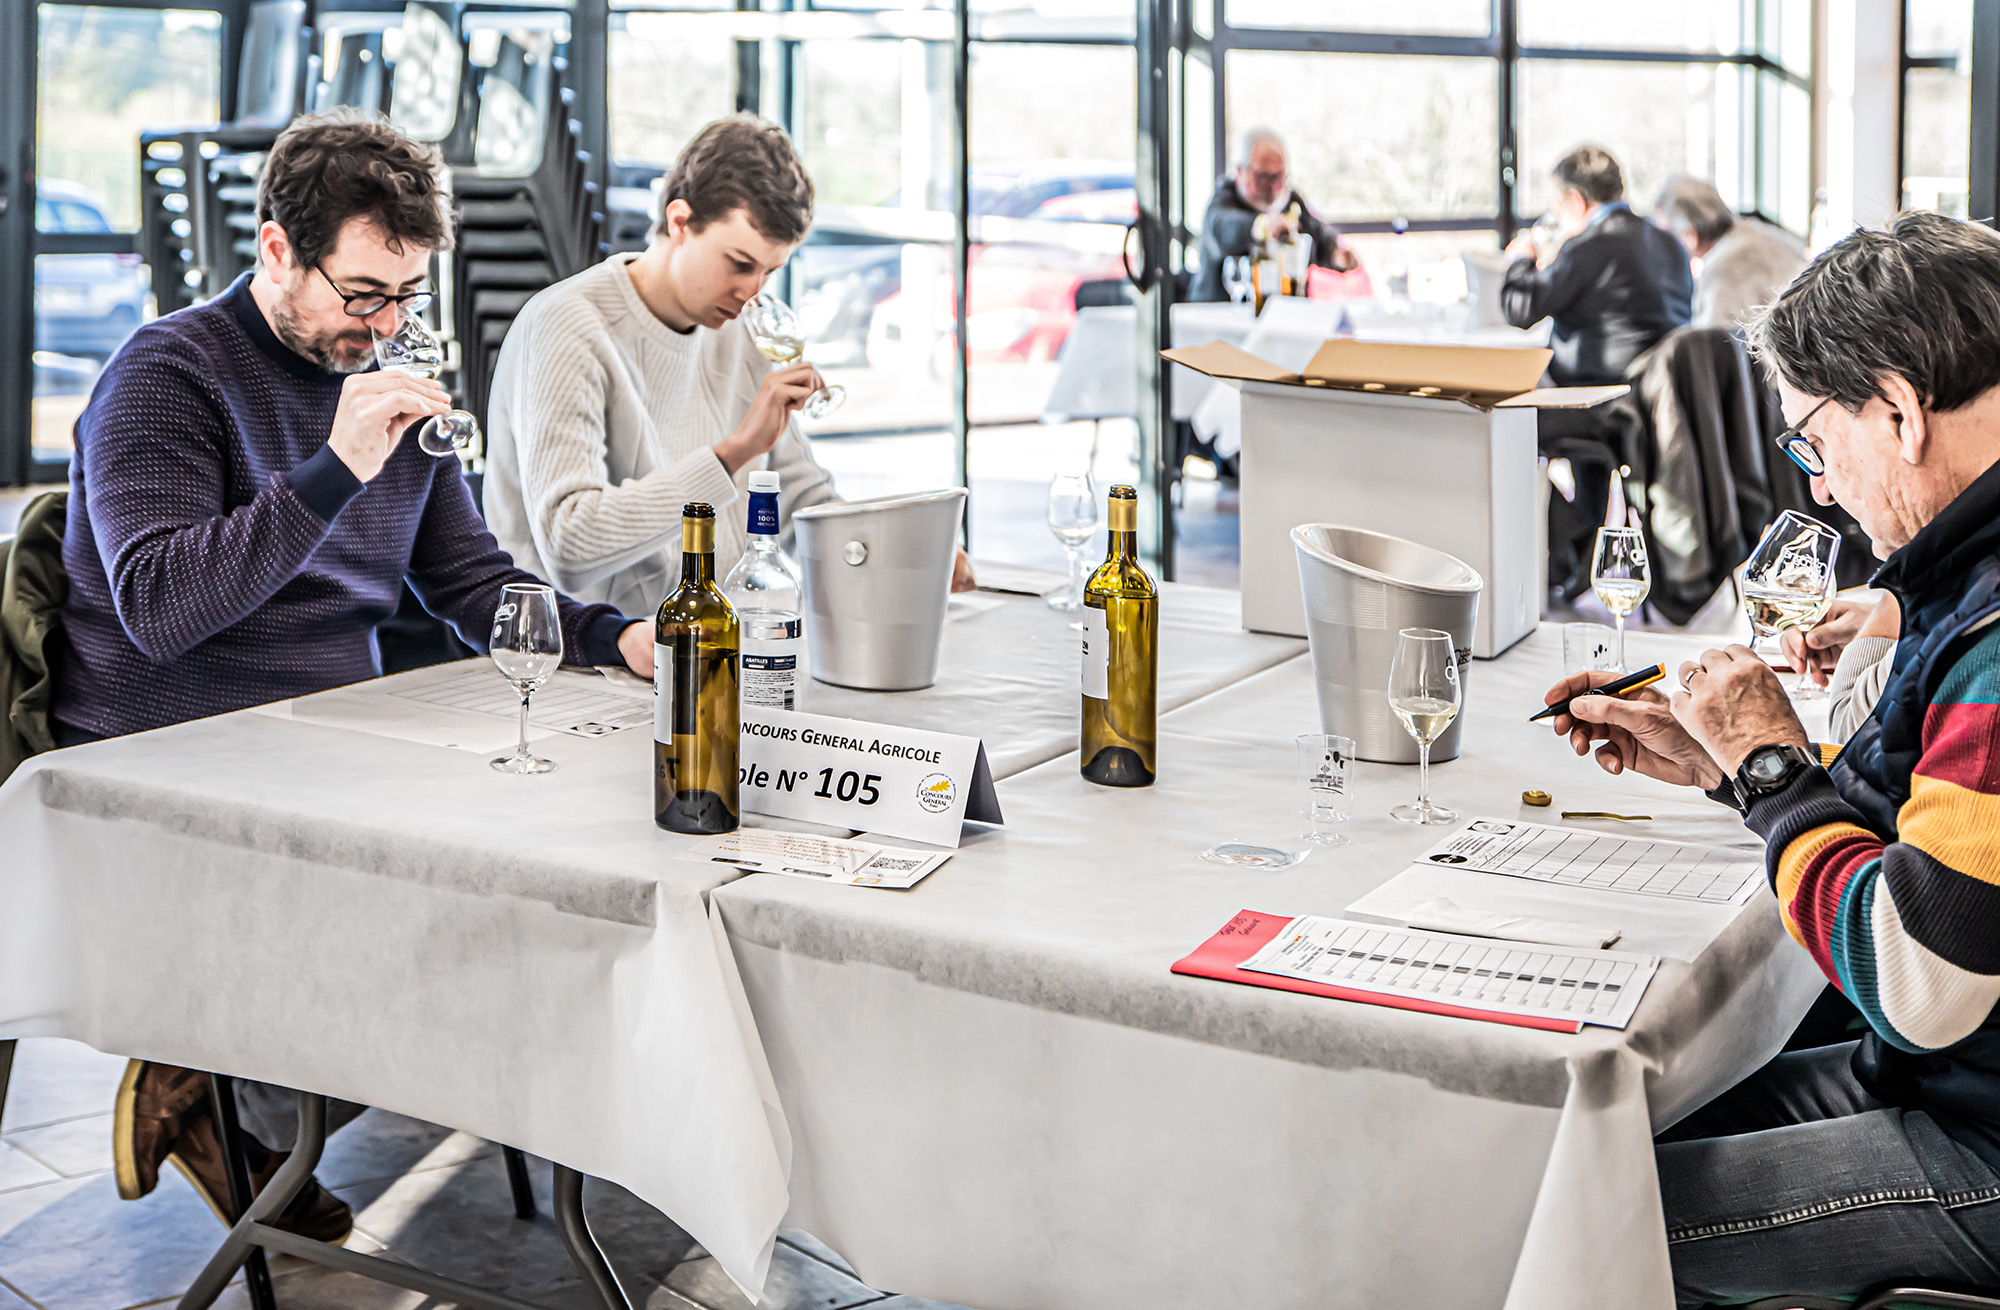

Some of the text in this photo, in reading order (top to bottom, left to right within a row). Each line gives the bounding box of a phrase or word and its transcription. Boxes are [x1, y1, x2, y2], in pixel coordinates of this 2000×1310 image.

[739, 722, 942, 764] NCOURS GENERAL AGRICOLE
[776, 769, 808, 792] N°
[814, 767, 883, 805] 105
